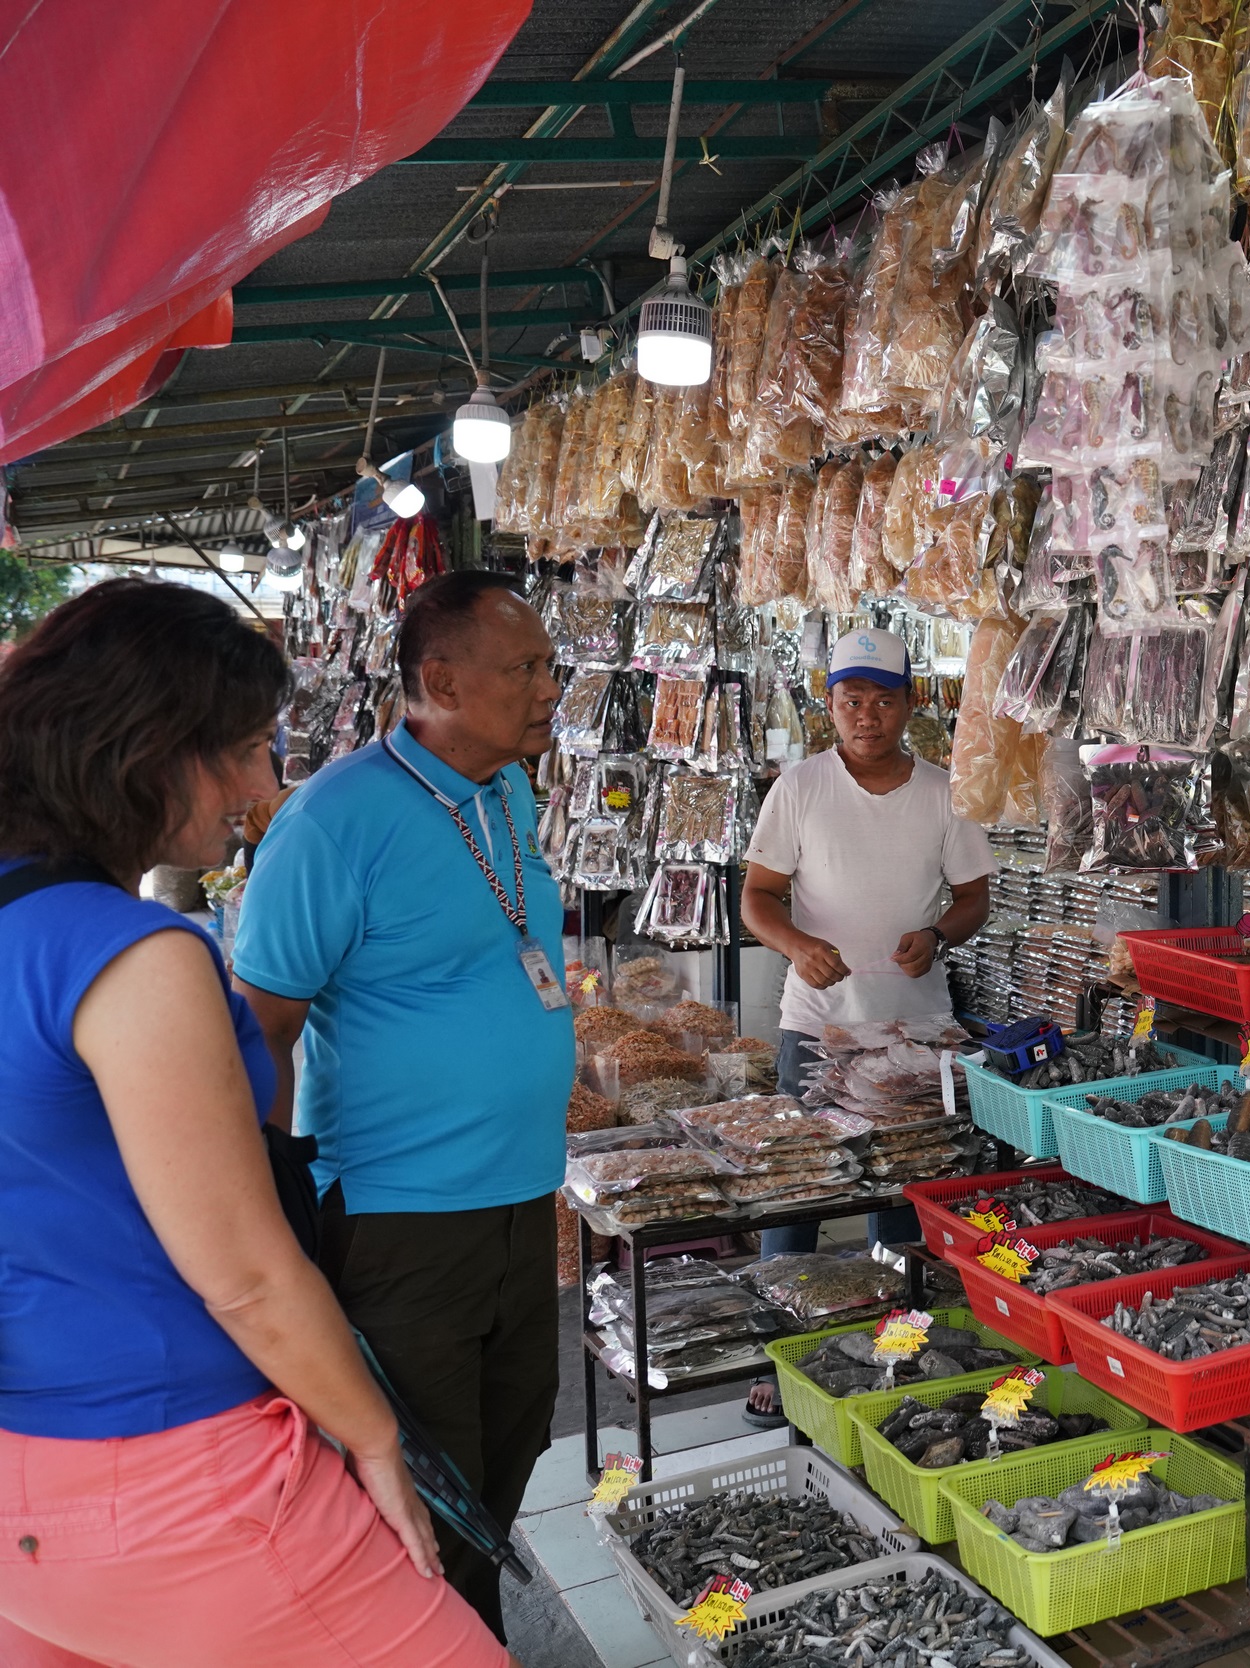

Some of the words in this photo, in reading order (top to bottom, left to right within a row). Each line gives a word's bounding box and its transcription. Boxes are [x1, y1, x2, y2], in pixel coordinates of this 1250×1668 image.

[1014, 1238, 1041, 1262] NEW
[907, 1308, 934, 1329] NEW
[1023, 1368, 1046, 1386] NEW
[622, 1453, 644, 1472] NEW
[729, 1577, 753, 1603] NEW
